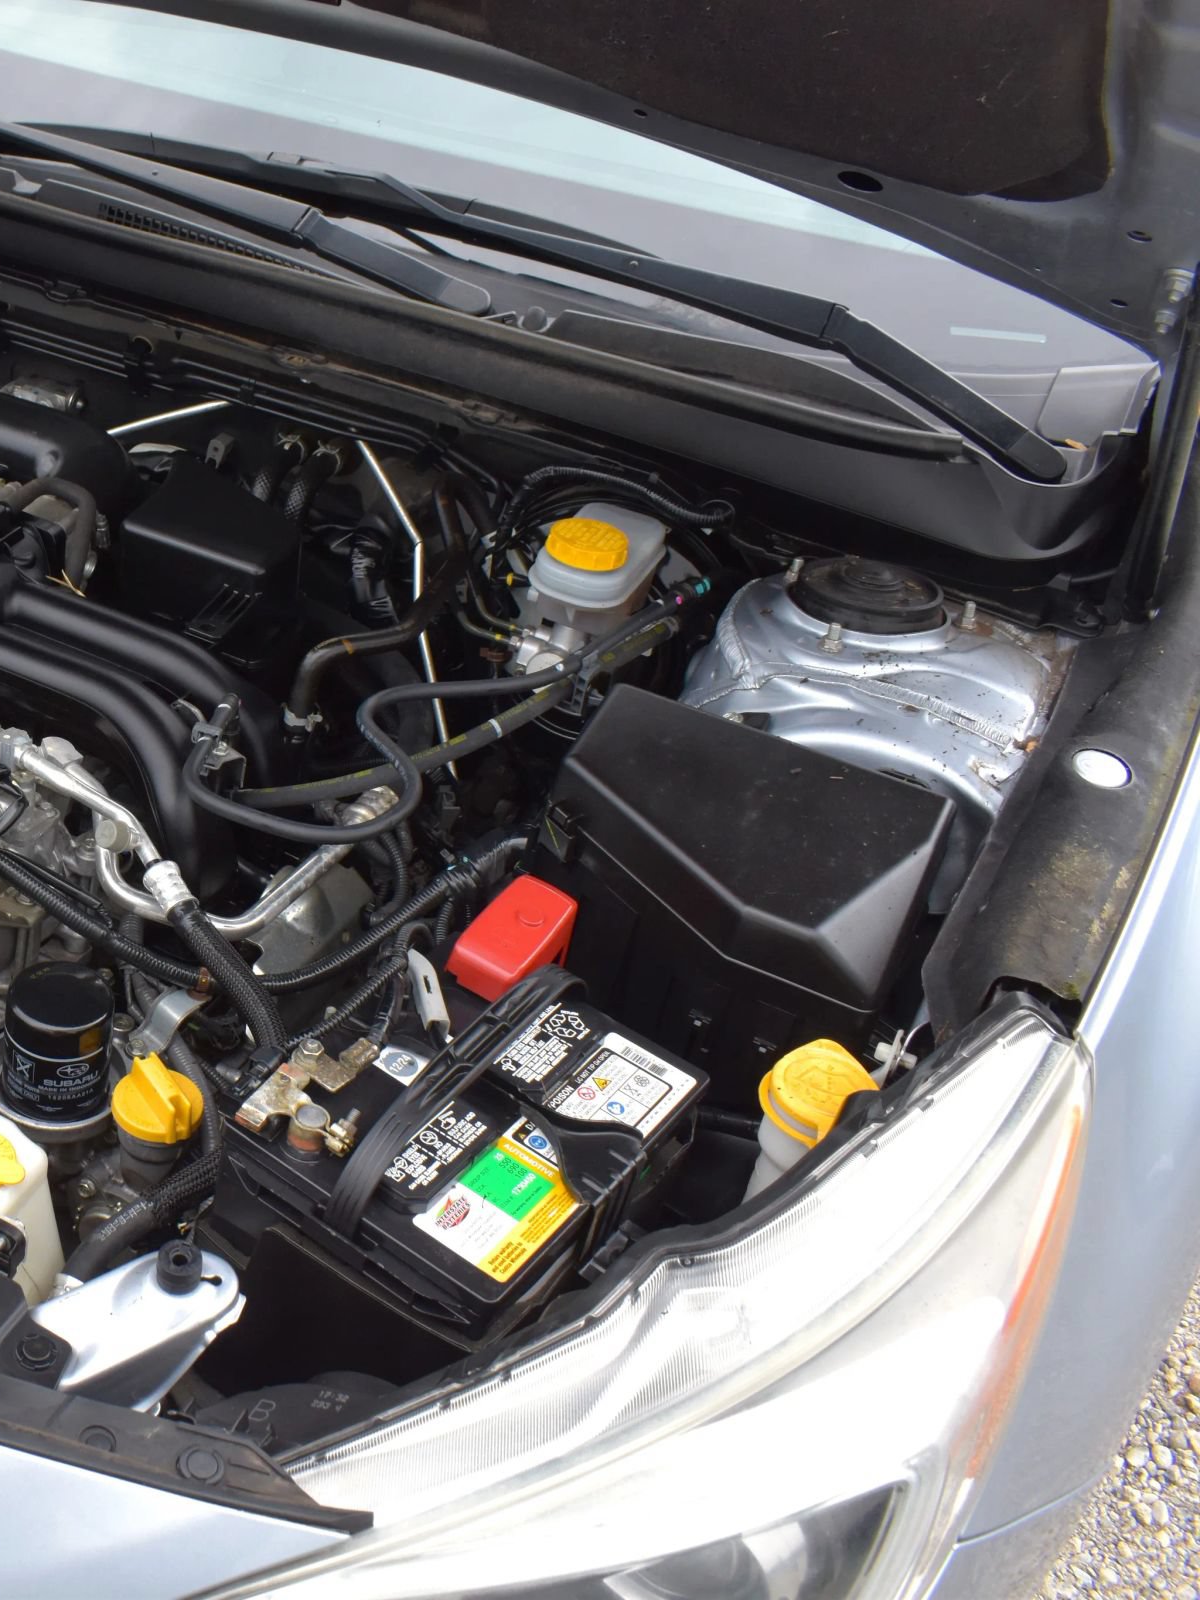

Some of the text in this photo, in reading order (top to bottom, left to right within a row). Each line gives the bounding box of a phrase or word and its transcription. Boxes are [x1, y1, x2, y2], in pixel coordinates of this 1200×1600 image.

[389, 1054, 411, 1072] 12/24
[43, 1070, 98, 1087] SUBARU
[498, 1157, 512, 1169] 550
[503, 1143, 555, 1178] AUTOMOTIVE
[506, 1162, 520, 1175] 690
[514, 1167, 528, 1179] 100
[435, 1196, 466, 1226] INTERSTATE
[442, 1202, 470, 1230] BATTERIES
[248, 1399, 276, 1421] B
